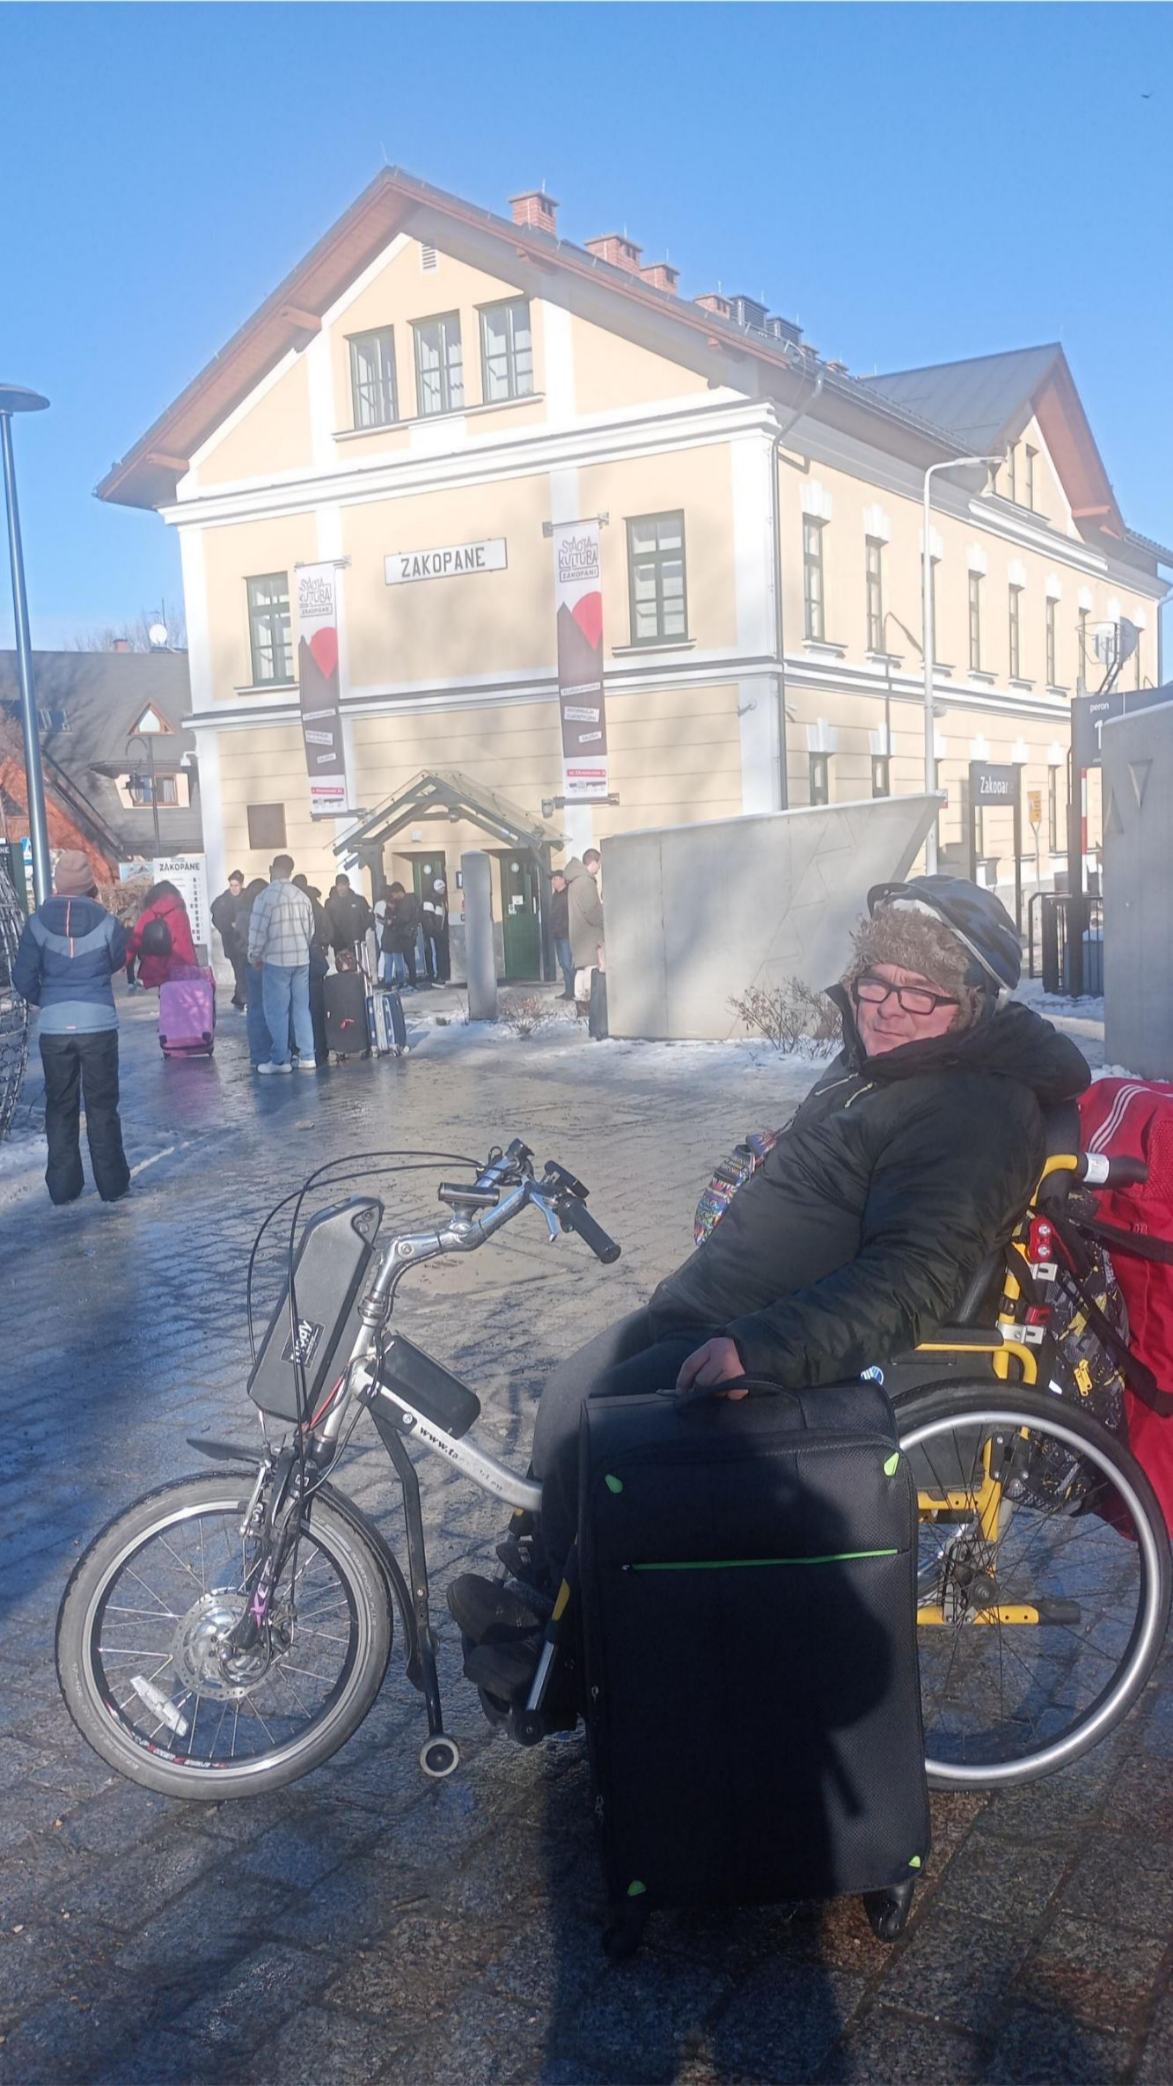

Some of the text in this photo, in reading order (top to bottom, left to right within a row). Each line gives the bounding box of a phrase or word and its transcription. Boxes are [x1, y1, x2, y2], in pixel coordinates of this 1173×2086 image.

[400, 546, 486, 578] ZAKOPANE
[1089, 702, 1110, 713] peron
[159, 862, 201, 872] ZAKOPANE
